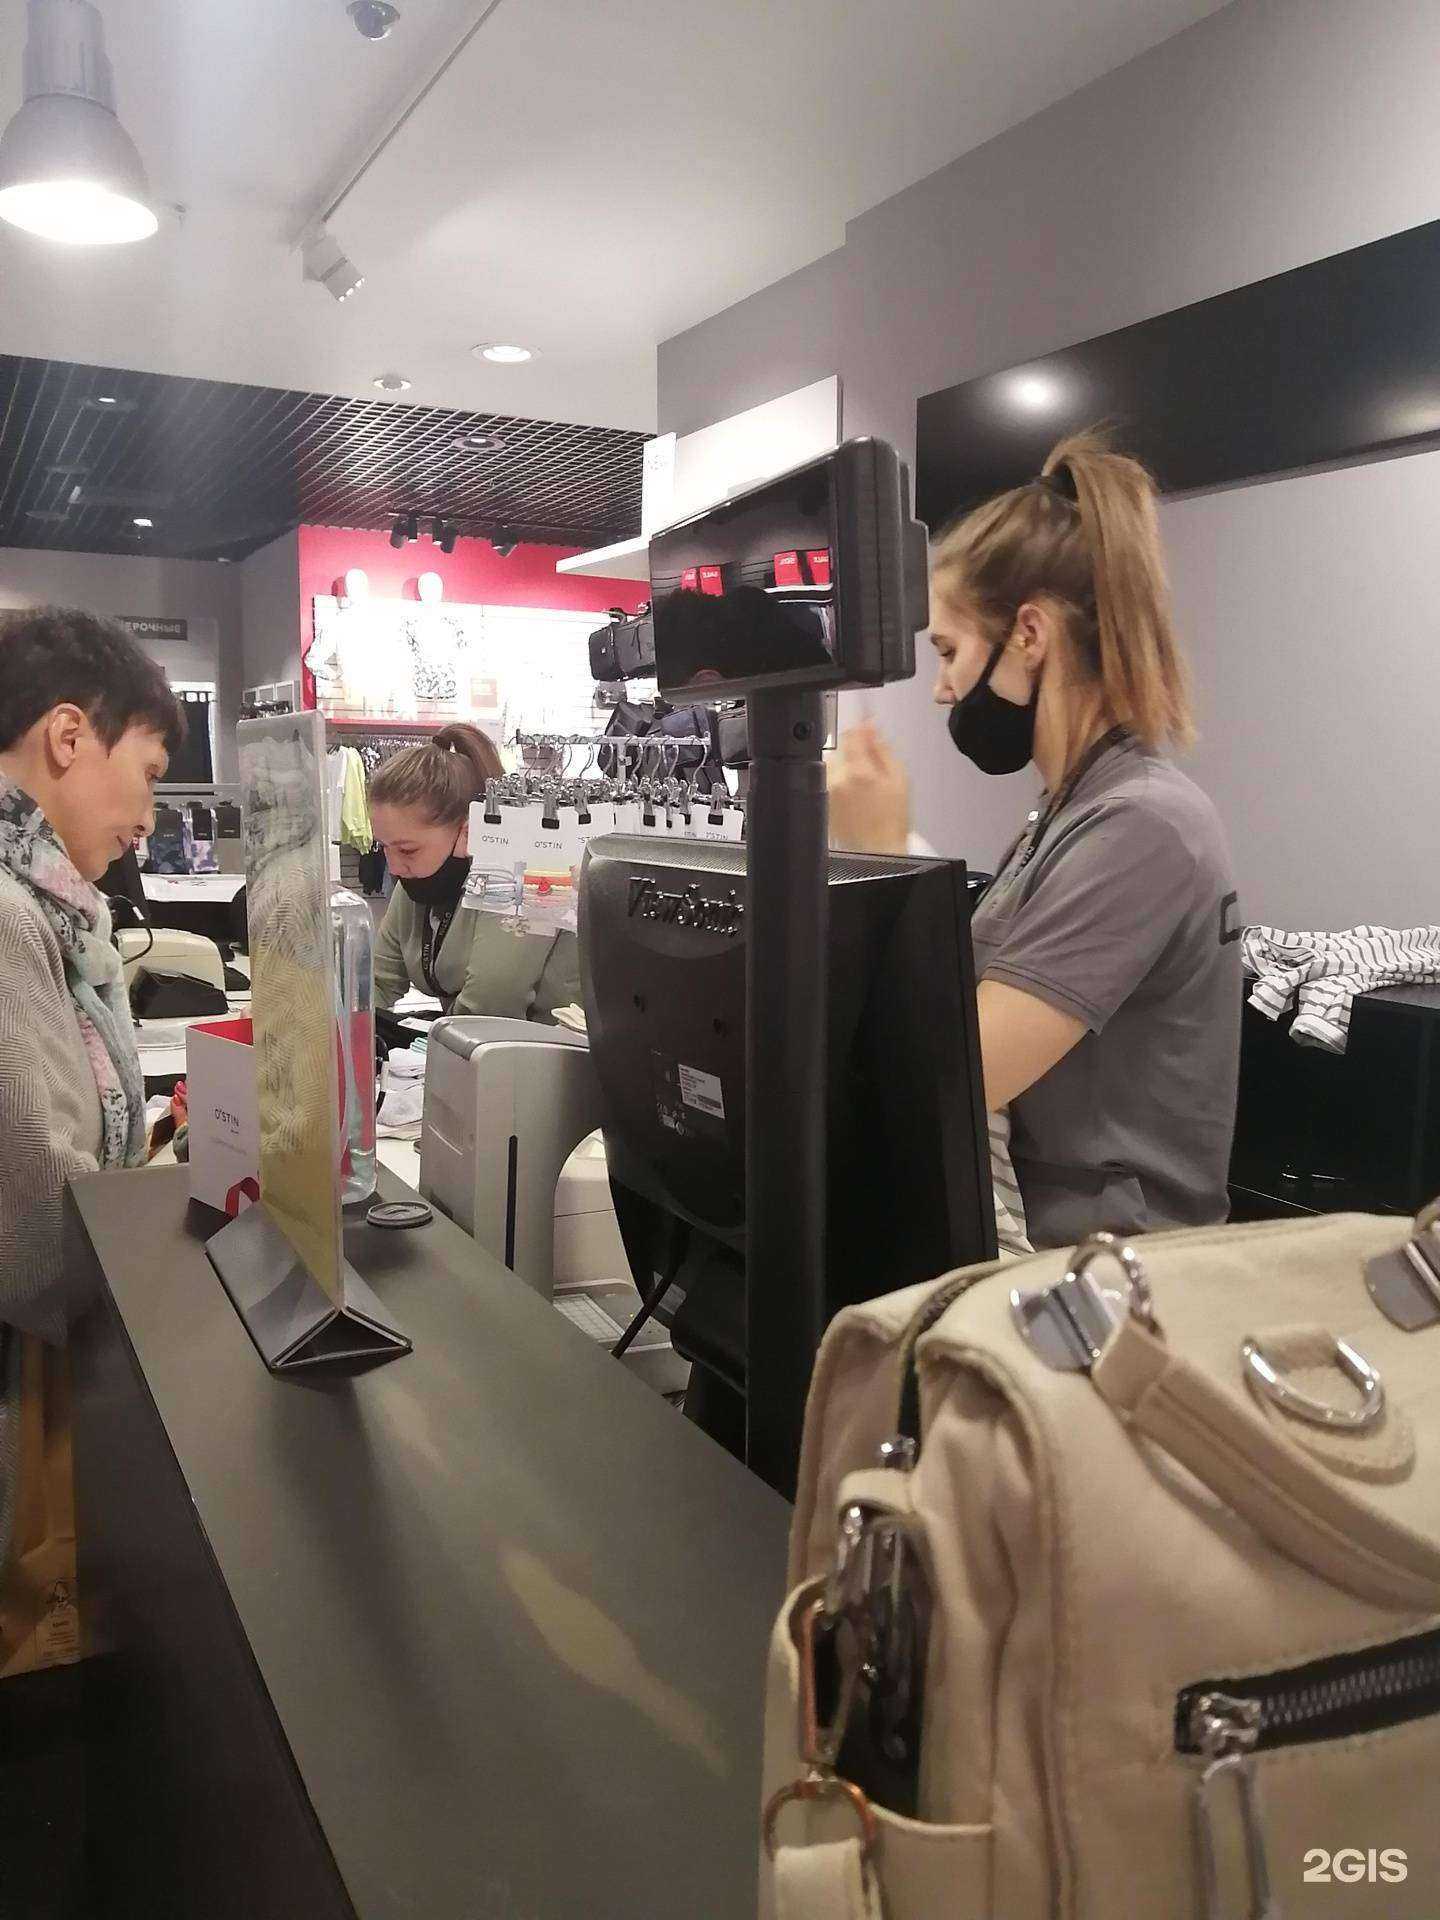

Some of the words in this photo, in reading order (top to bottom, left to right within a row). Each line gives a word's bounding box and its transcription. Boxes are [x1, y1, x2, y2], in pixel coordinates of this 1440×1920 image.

[120, 621, 181, 634] ЕРОЧНЫЕ
[481, 834, 509, 845] O'STIN
[534, 840, 563, 850] O'STIN
[214, 1108, 240, 1127] O'STIN
